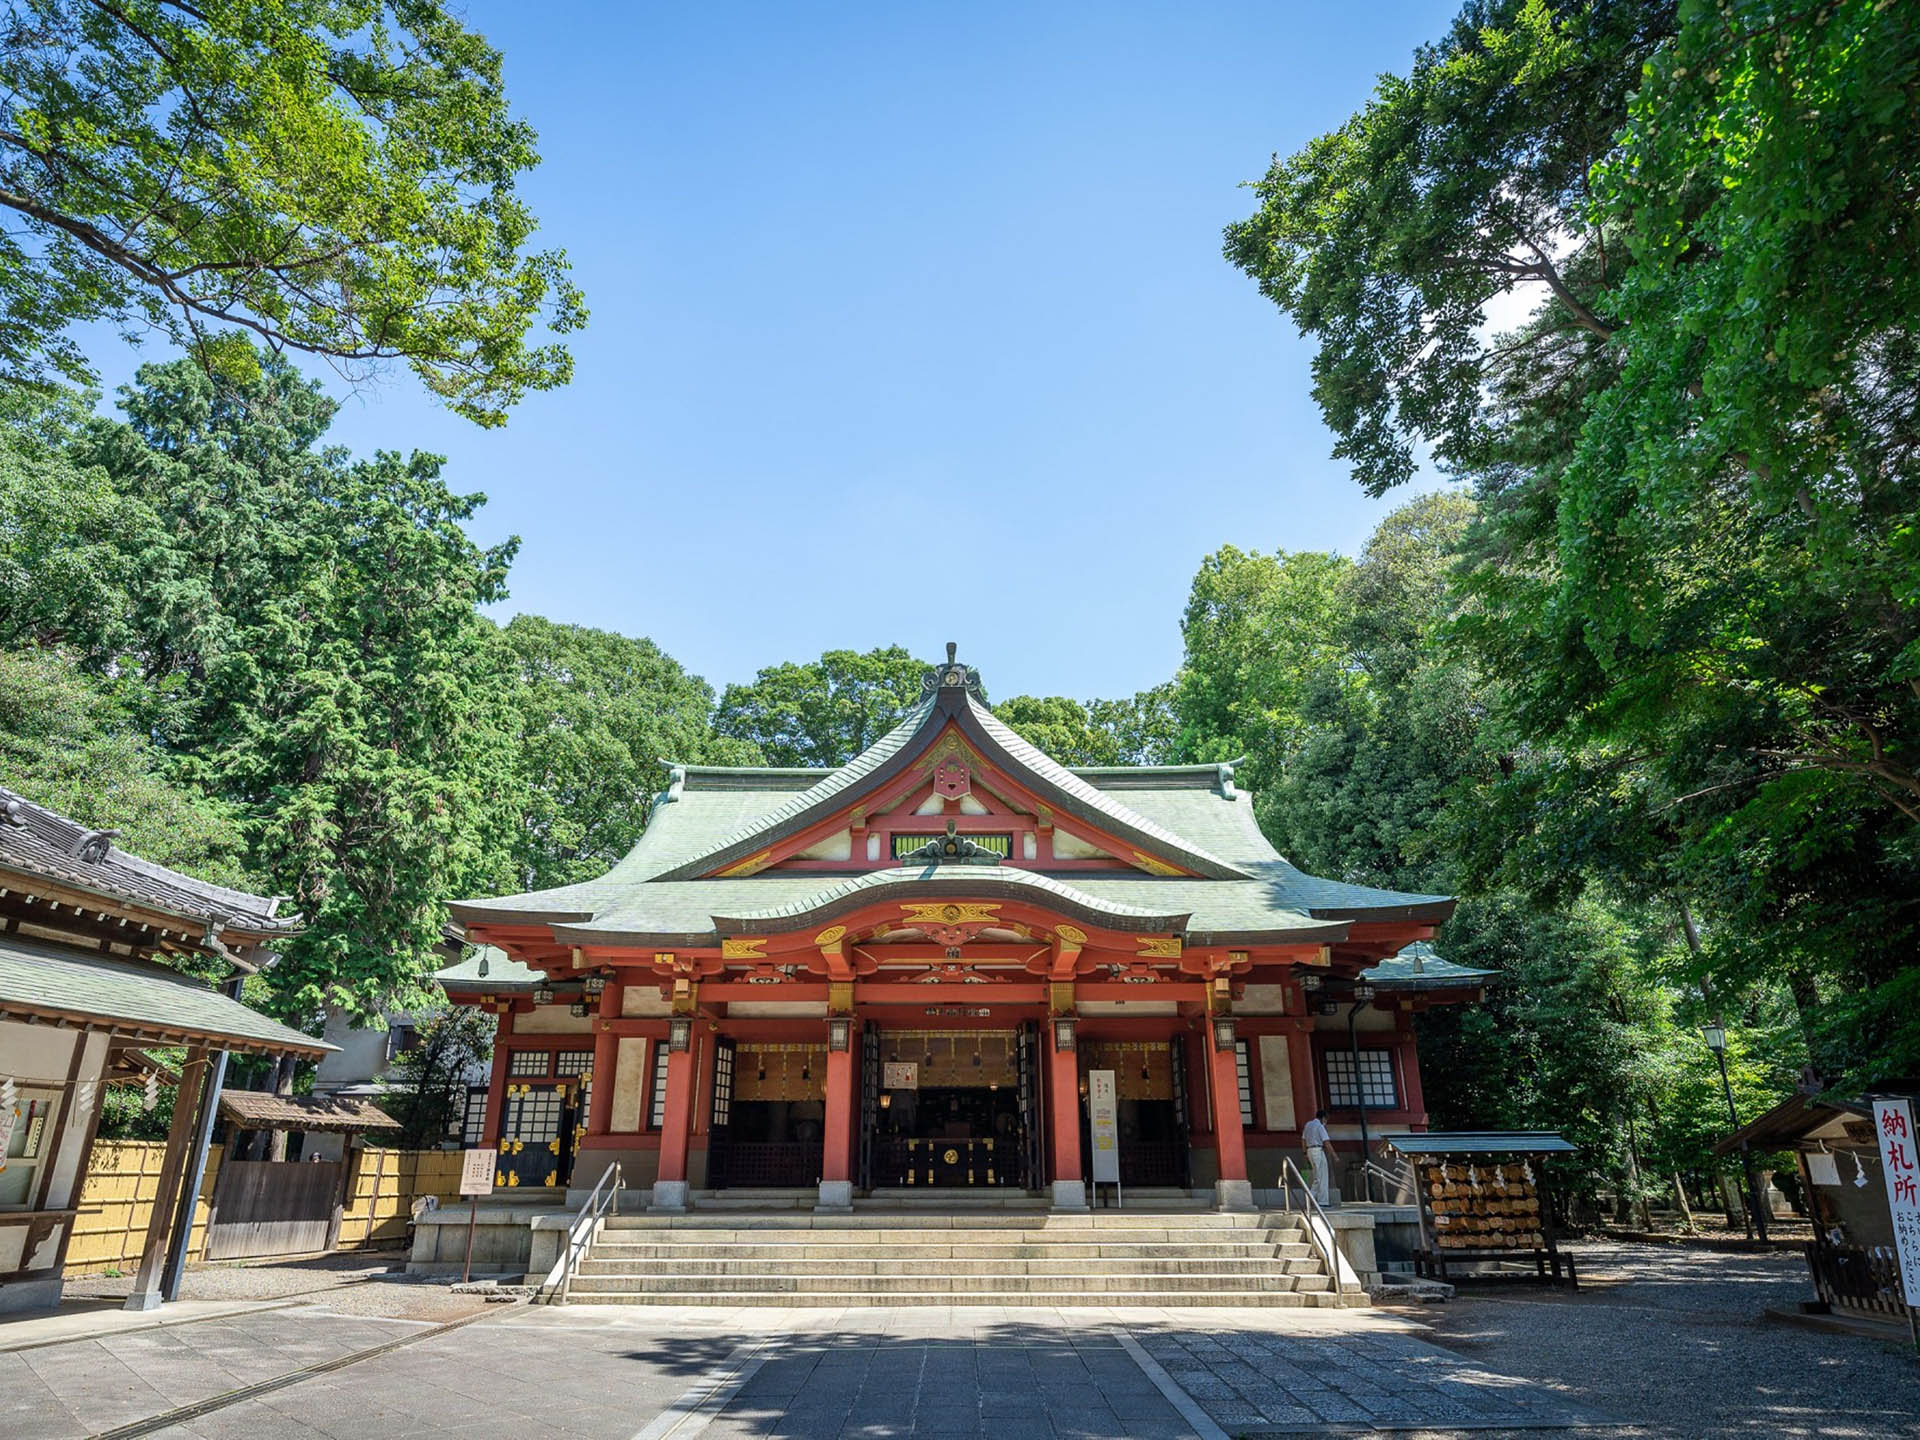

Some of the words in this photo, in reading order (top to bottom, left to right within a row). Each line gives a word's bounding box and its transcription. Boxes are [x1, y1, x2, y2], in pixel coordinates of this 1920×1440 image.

[1881, 1108, 1917, 1208] 納札所
[1896, 1210, 1918, 1294] お納めください
